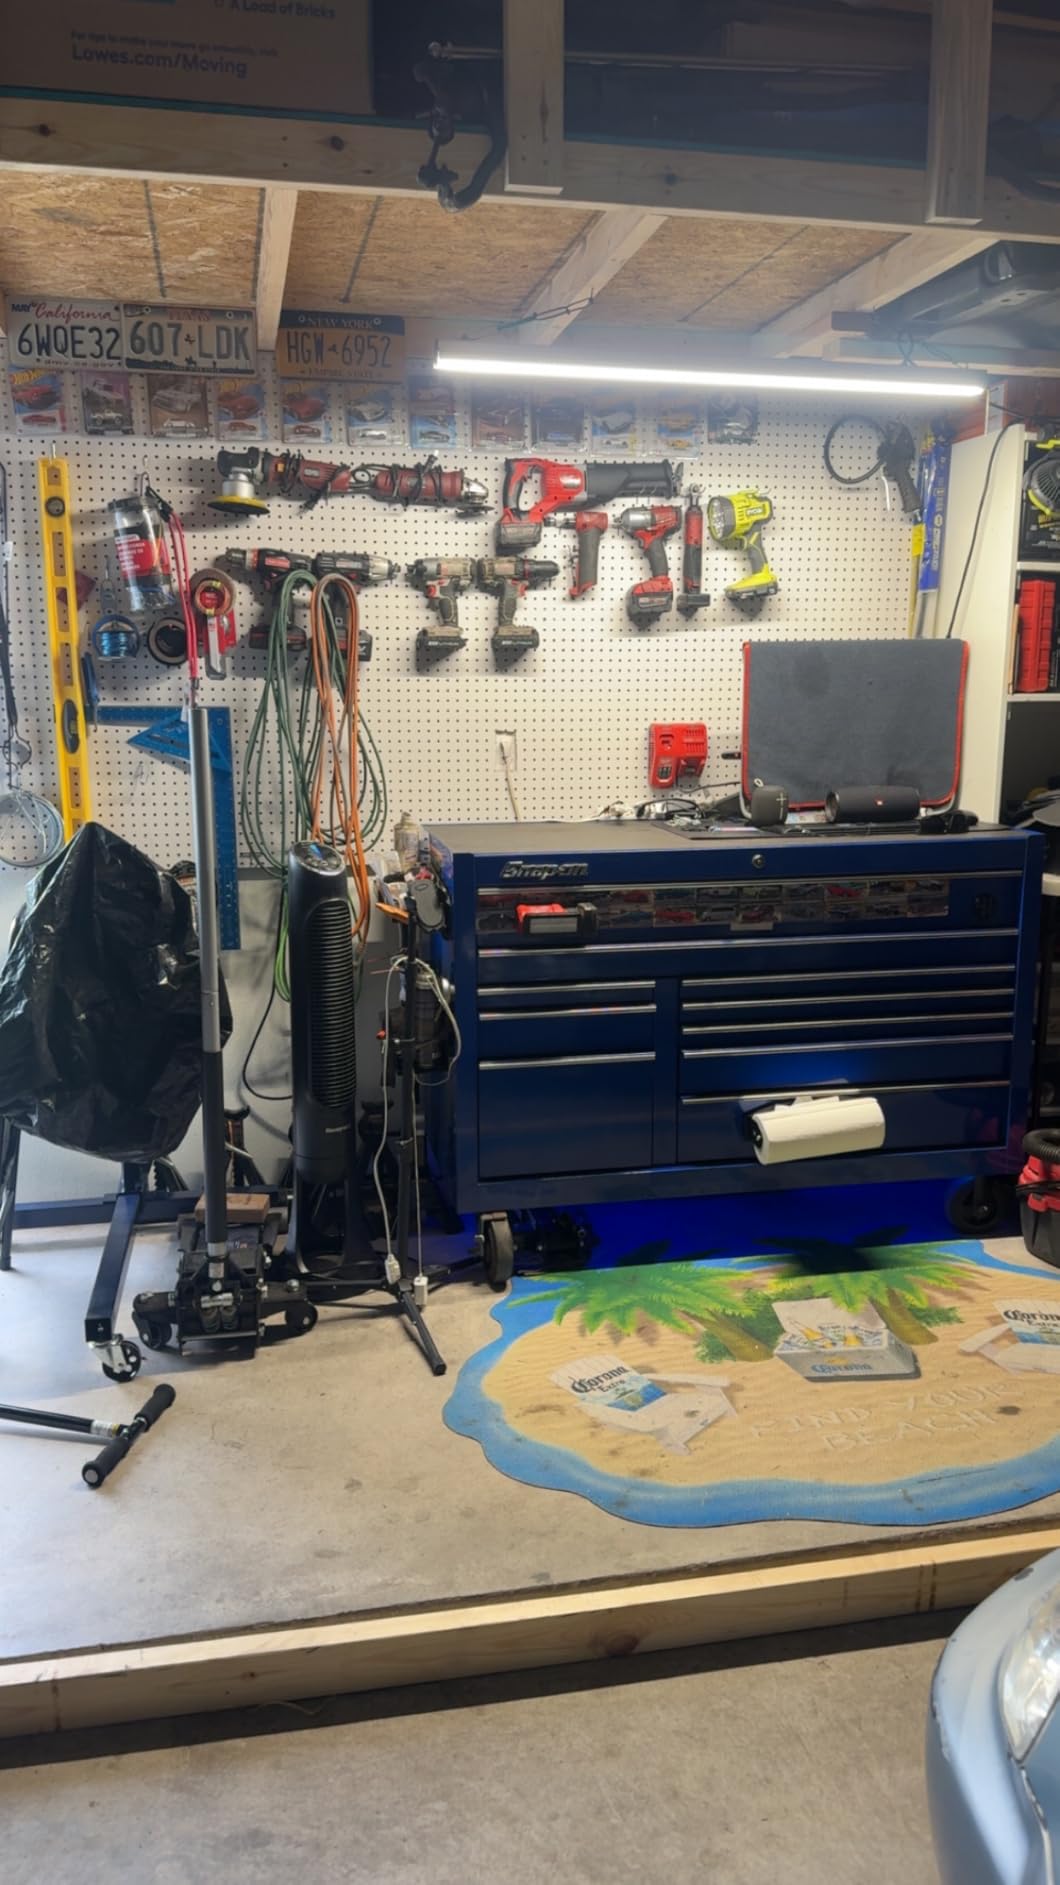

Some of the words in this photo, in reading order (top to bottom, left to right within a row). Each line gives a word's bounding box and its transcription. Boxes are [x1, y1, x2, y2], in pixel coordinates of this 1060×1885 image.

[240, 0, 274, 13] Load
[278, 2, 292, 14] of
[294, 2, 336, 18] Bricks
[71, 43, 248, 79] Lowes.com/Moving
[35, 302, 114, 323] California
[307, 317, 337, 328] NEW
[342, 319, 373, 329] YORK
[17, 323, 121, 360] 6WQE32
[1003, 1309, 1060, 1322] Coron
[569, 1366, 630, 1393] Corona
[750, 1406, 873, 1439] FIND
[884, 1382, 1014, 1412] YOUR
[822, 1408, 998, 1450] BEACH
